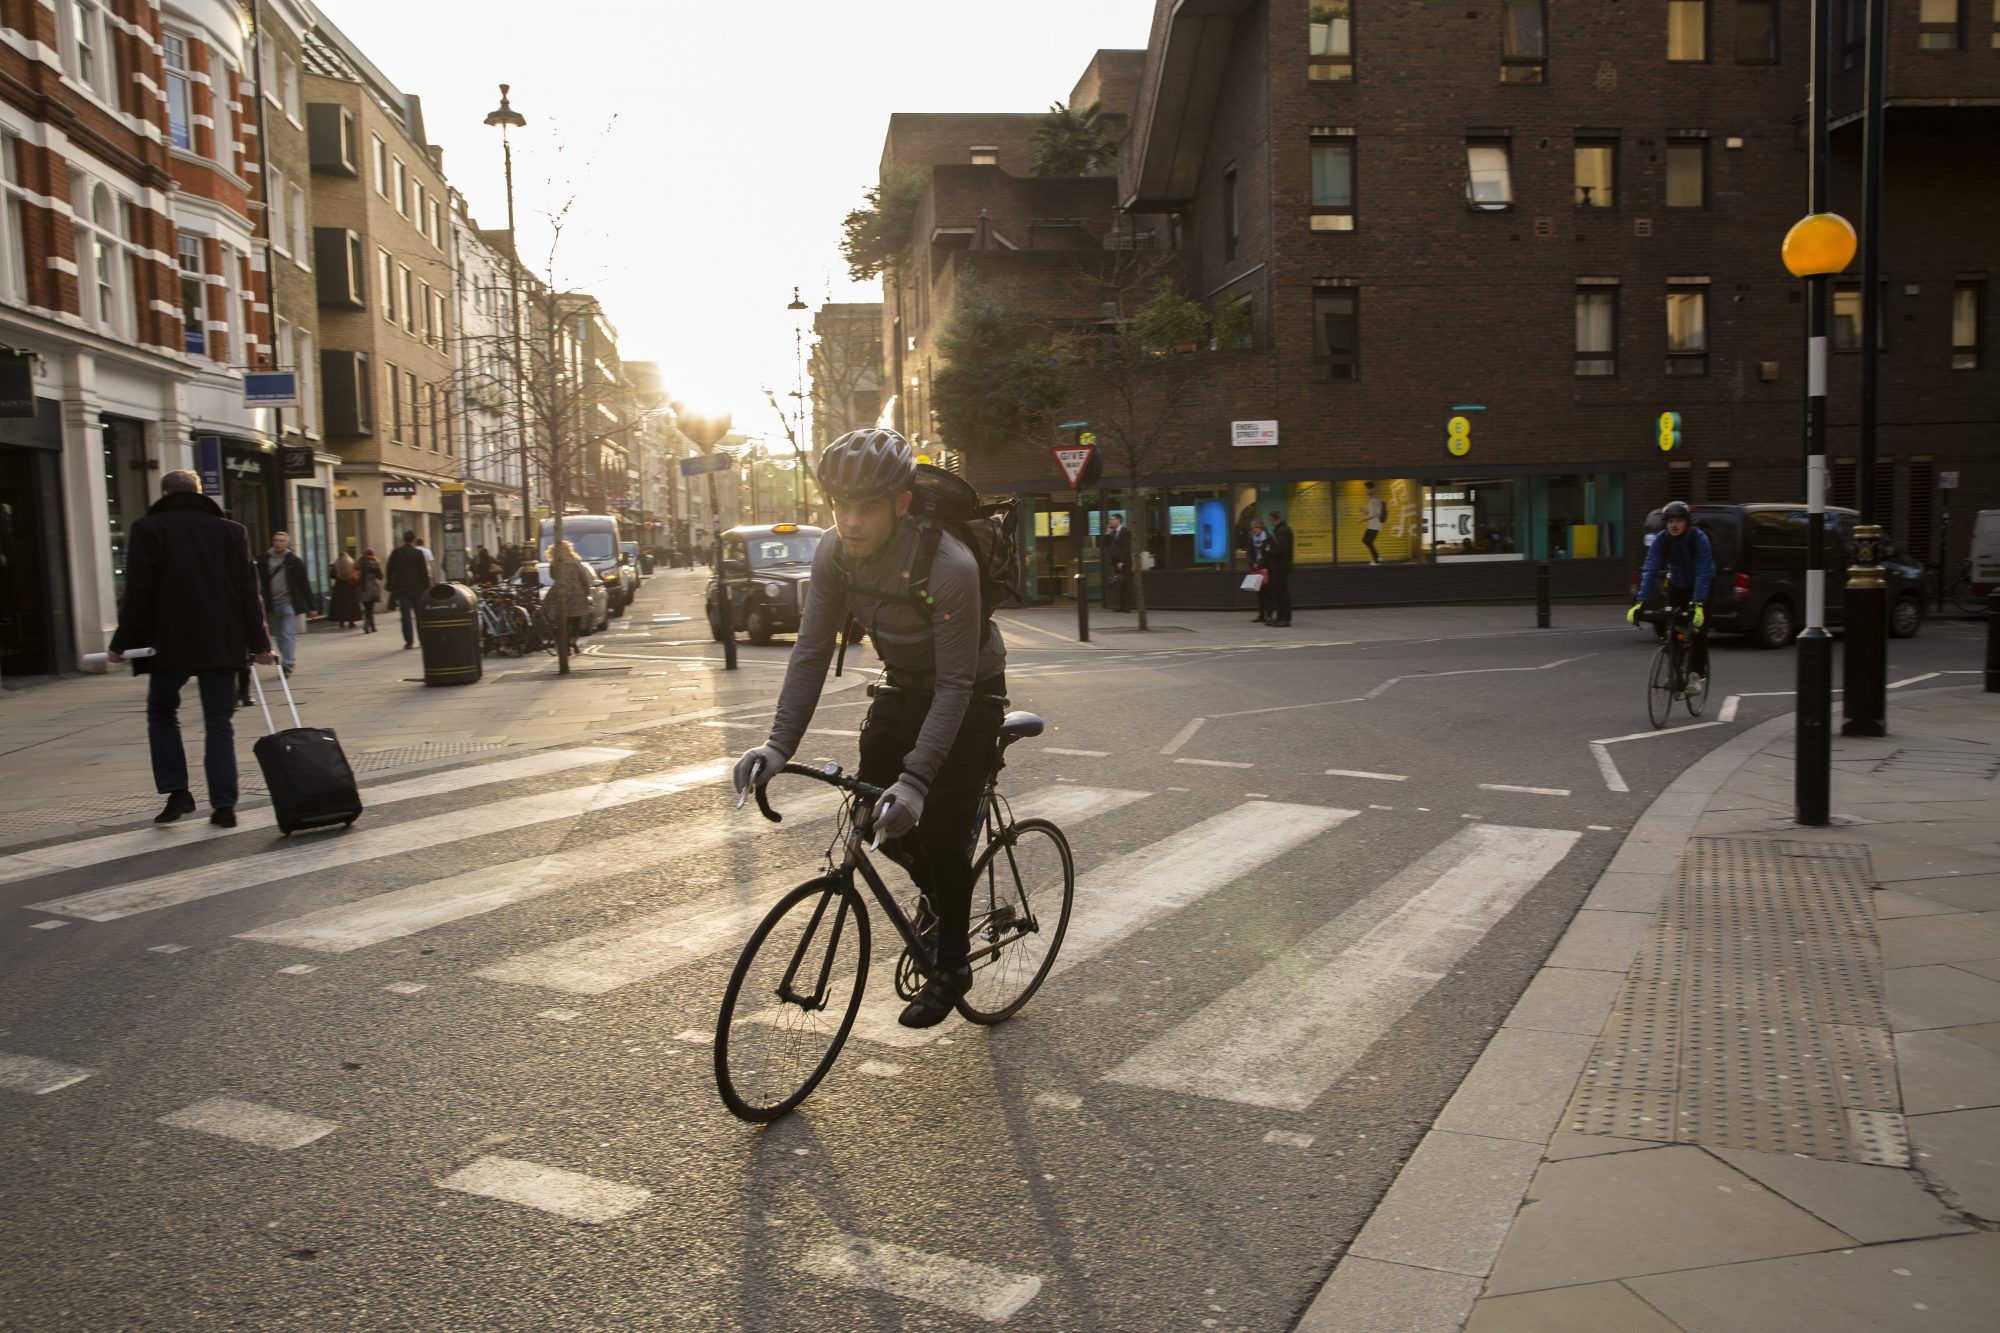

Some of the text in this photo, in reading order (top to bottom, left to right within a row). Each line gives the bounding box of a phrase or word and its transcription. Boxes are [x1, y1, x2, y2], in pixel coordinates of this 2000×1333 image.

[1235, 423, 1259, 431] ENDELL
[1236, 431, 1259, 439] STREET
[1060, 451, 1085, 460] GIVE
[384, 486, 415, 494] ZARA
